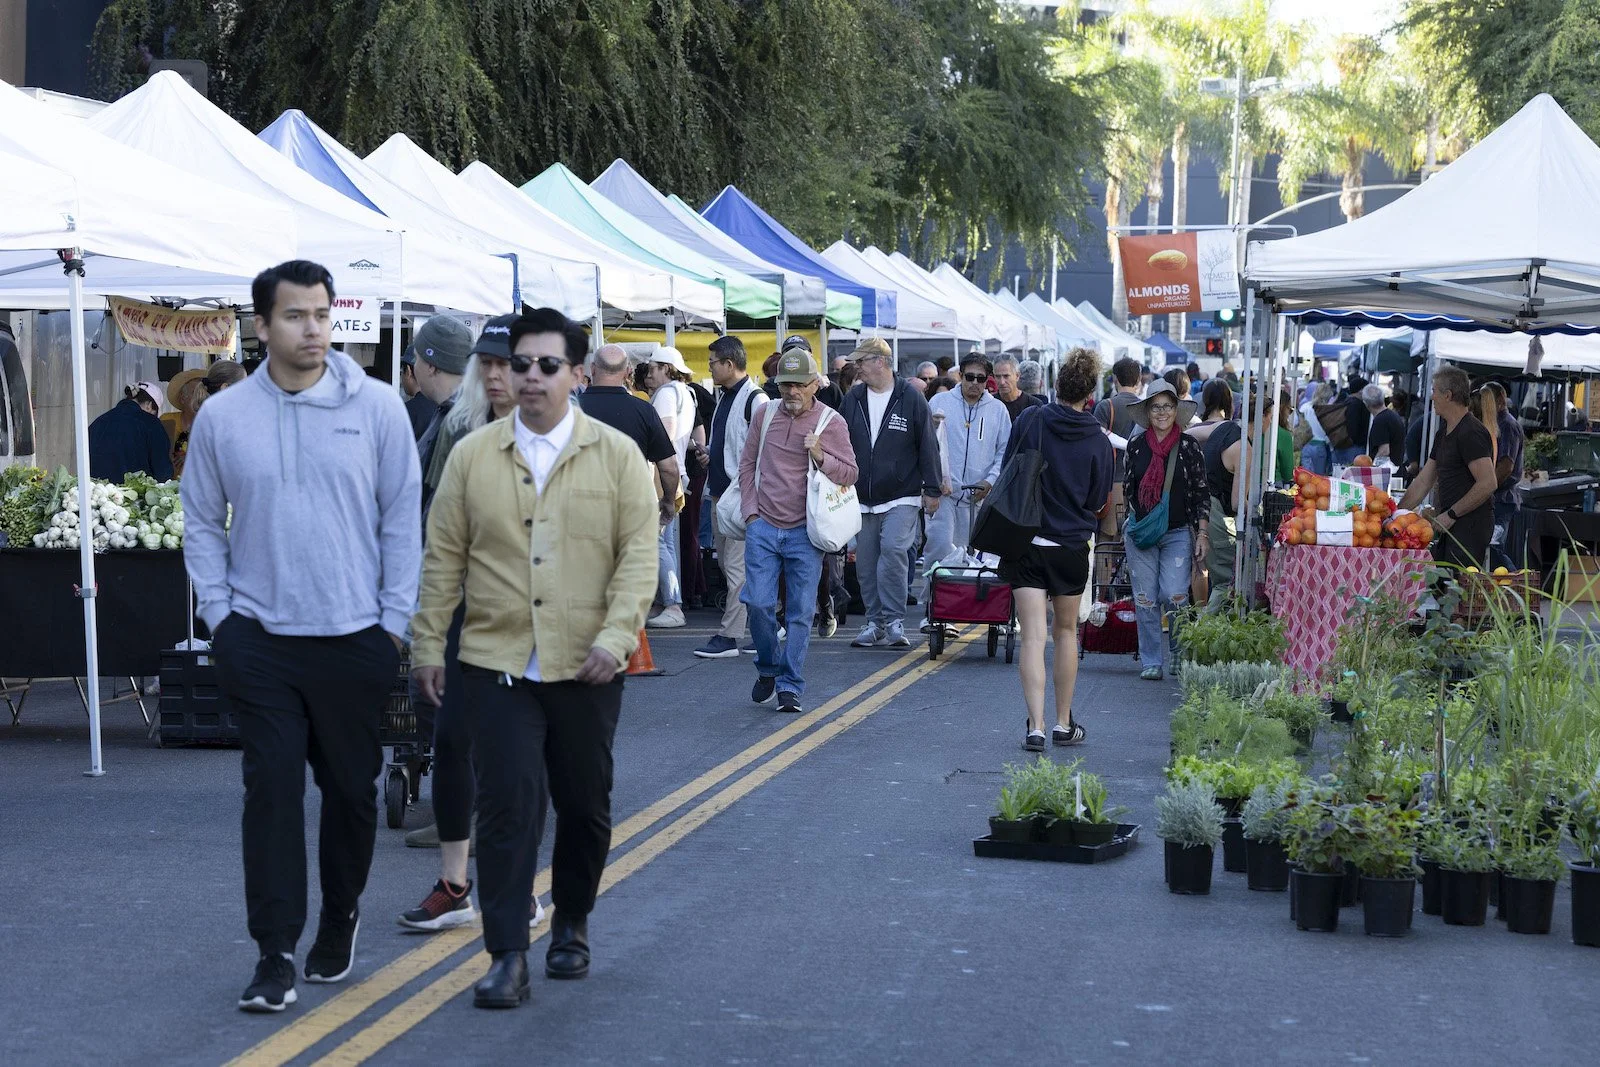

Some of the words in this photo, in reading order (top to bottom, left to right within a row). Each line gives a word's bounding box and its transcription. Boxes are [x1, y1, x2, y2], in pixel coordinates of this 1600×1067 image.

[1128, 283, 1190, 298] ALMONDS
[331, 299, 363, 309] UMMY
[1147, 301, 1191, 309] UNPASTEURIZED
[330, 320, 372, 332] ATES
